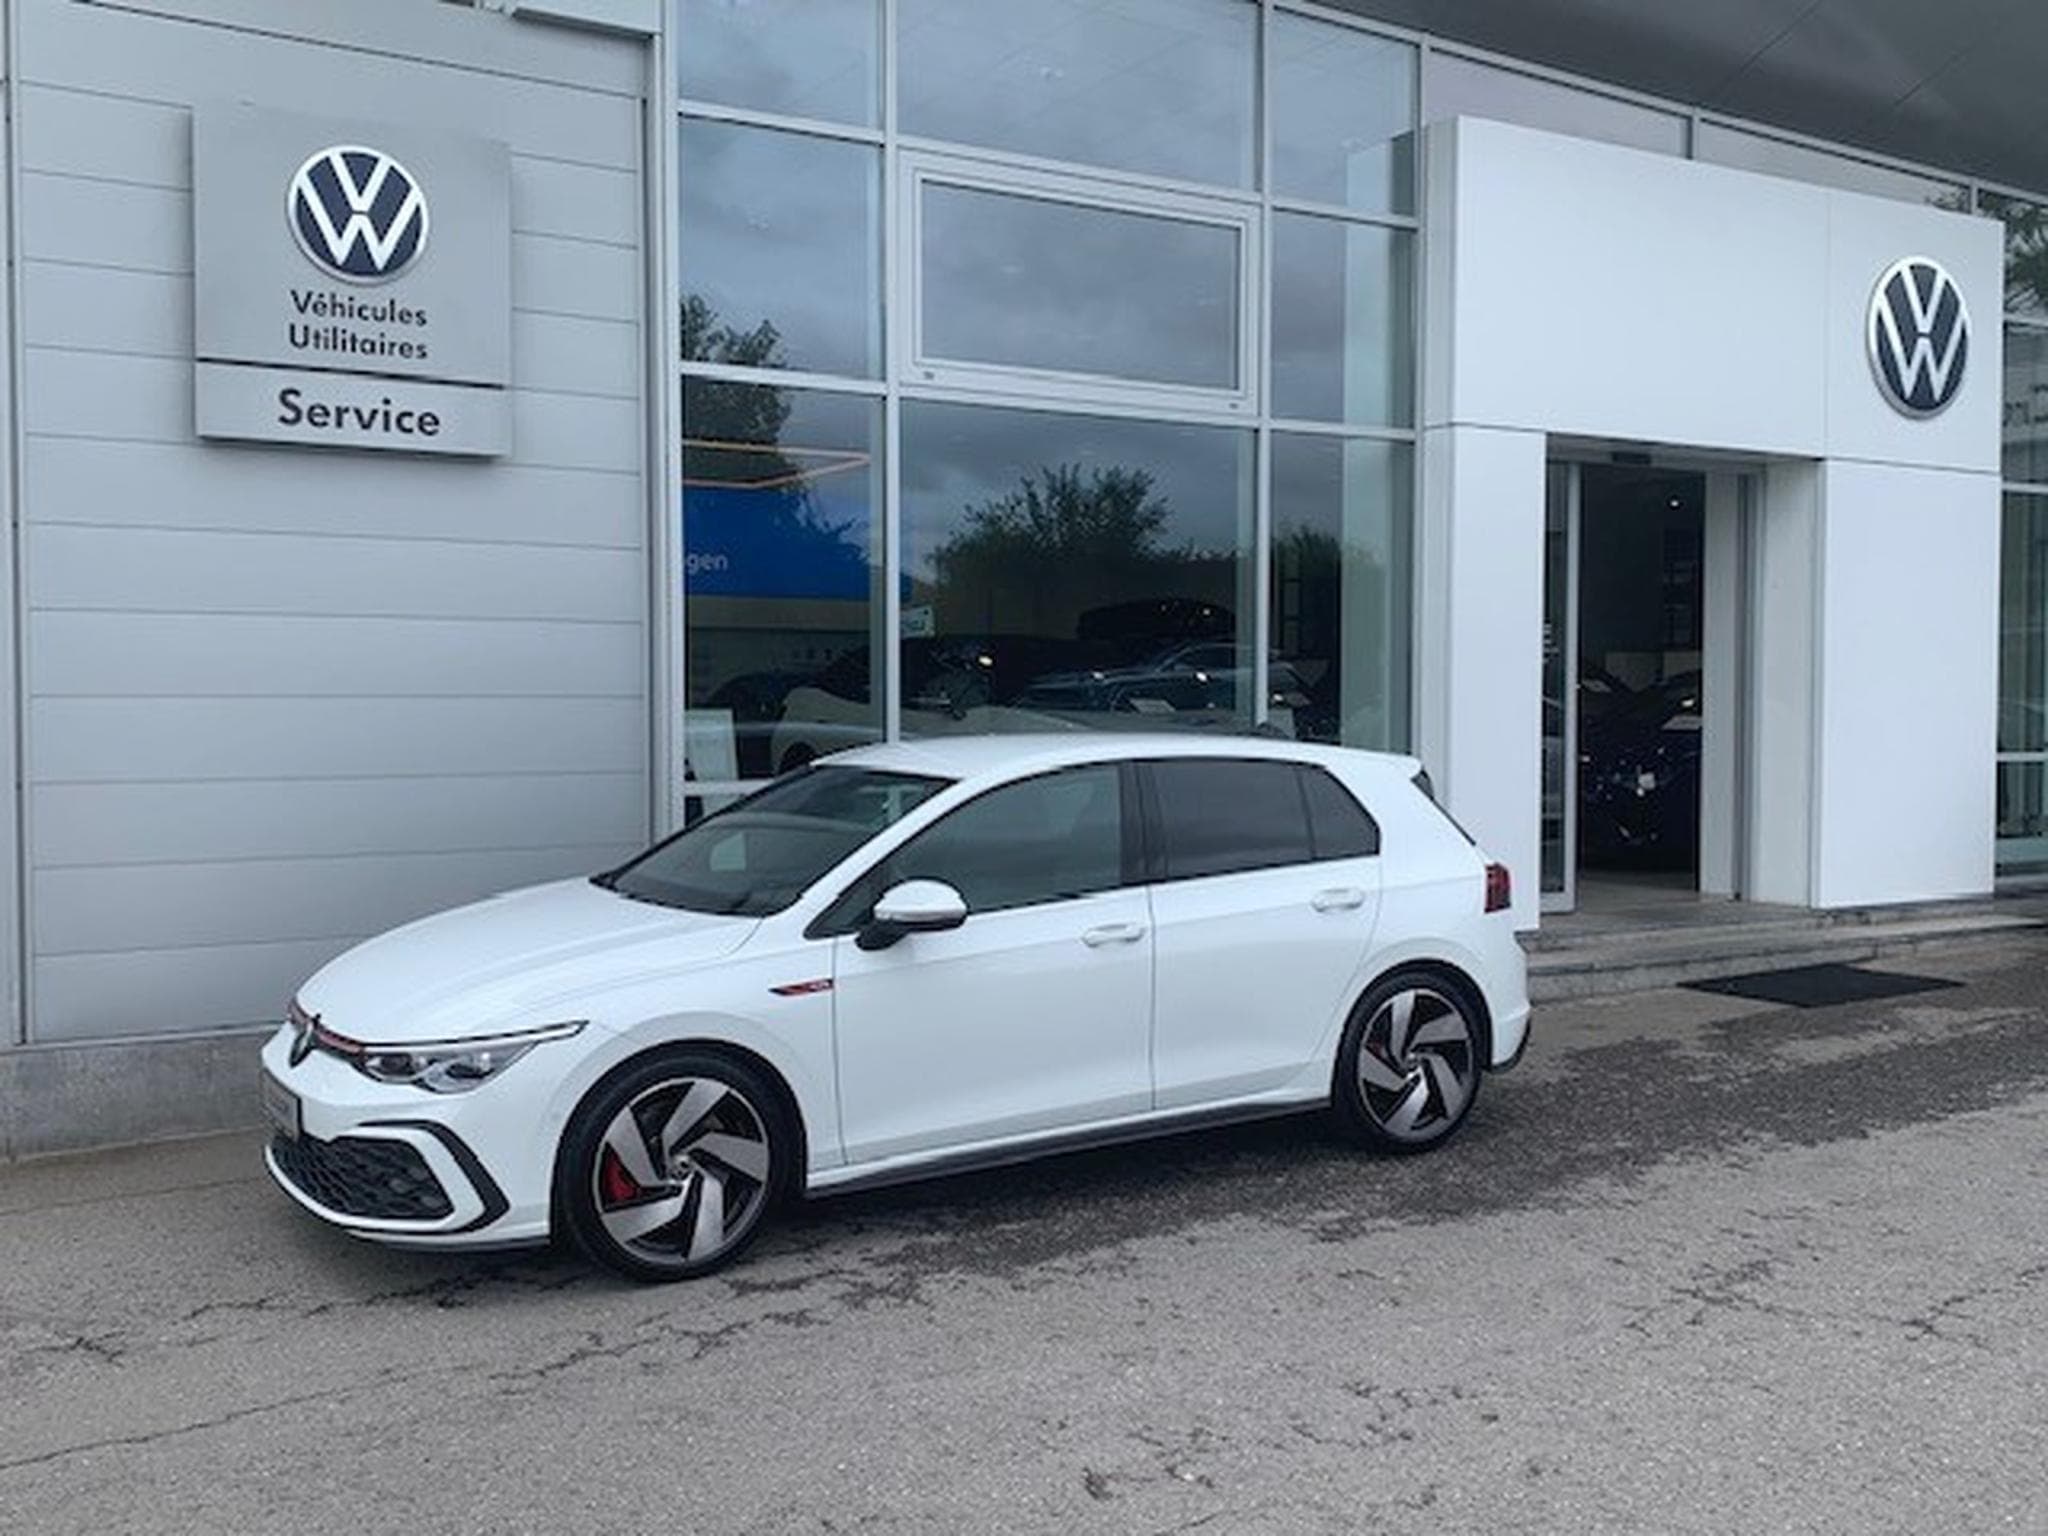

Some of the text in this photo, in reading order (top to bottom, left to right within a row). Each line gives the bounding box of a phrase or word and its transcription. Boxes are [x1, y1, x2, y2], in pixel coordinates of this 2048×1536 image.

[293, 148, 426, 277] VW
[290, 289, 428, 326] Véhicules
[288, 324, 429, 359] Utilitaires
[1870, 258, 1970, 408] VW
[278, 388, 441, 437] Service
